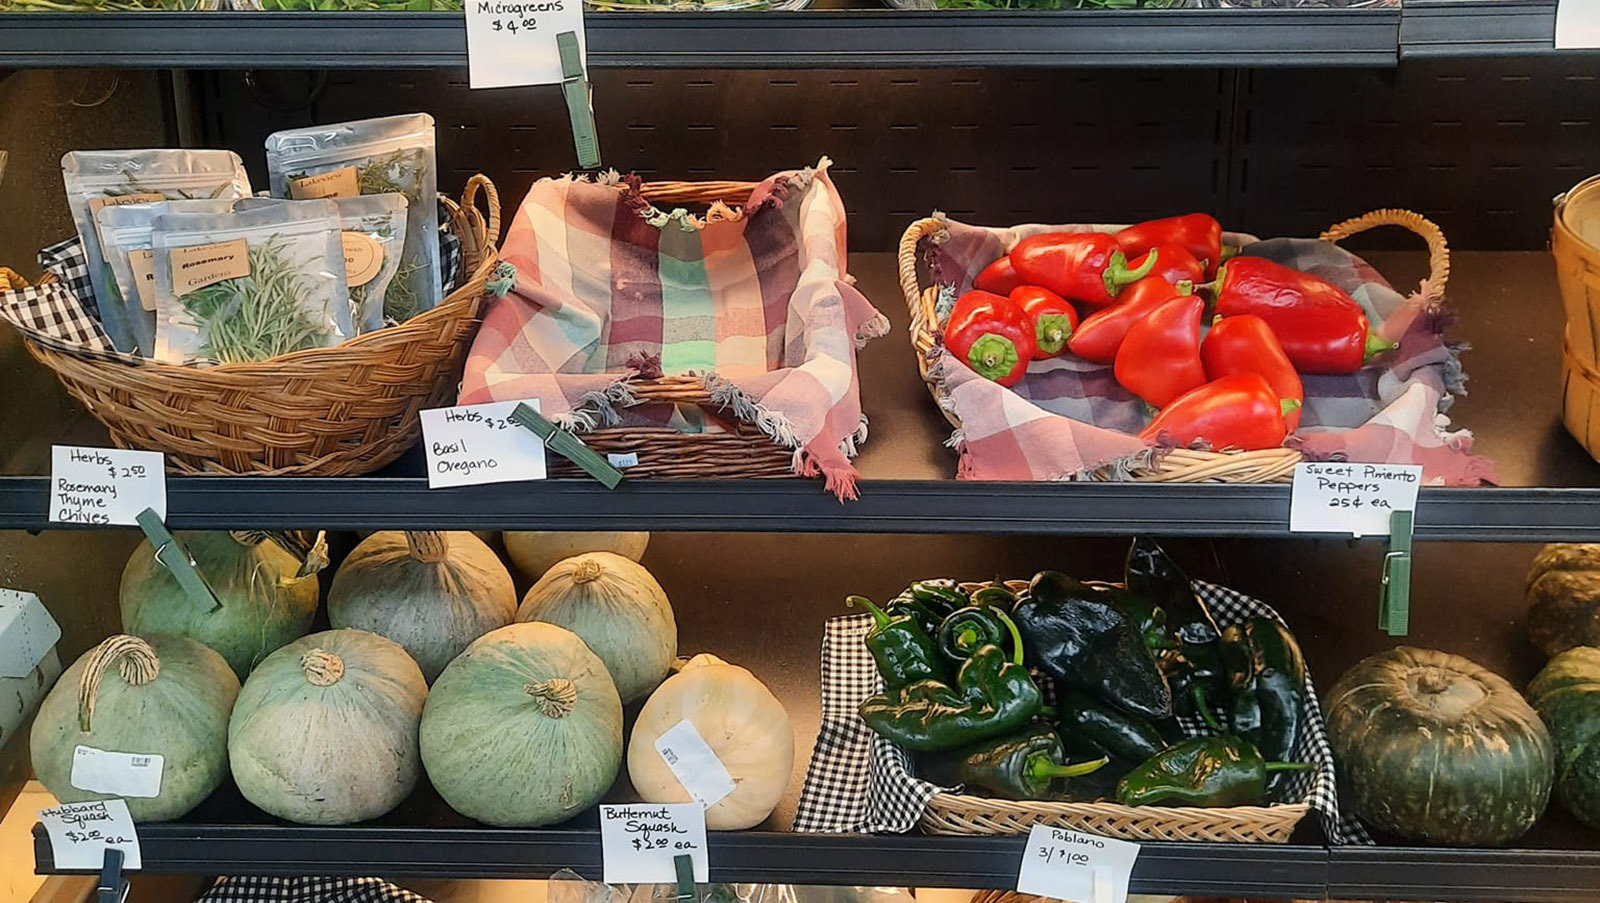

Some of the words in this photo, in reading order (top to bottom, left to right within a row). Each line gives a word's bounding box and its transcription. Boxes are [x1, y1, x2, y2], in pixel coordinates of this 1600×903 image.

[477, 0, 564, 19] Microgreens
[182, 255, 234, 269] Rosemary
[188, 271, 232, 286] Gardens
[445, 409, 482, 423] Herbs
[433, 438, 467, 456] Basil
[70, 449, 113, 465] Herbs
[437, 459, 498, 475] Oregano
[1306, 464, 1354, 477] Sweet
[58, 478, 117, 499] Rosemary
[1316, 477, 1380, 494] Peppers
[58, 494, 107, 512] Thyme
[1370, 498, 1392, 509] ea
[58, 508, 110, 524] Chives
[41, 801, 108, 817] Hubbard
[603, 807, 672, 820] Butternut
[61, 812, 114, 829] Squash
[624, 820, 688, 840] Squash
[105, 836, 133, 844] ea
[674, 841, 698, 849] ea
[1051, 829, 1105, 849] Poblano
